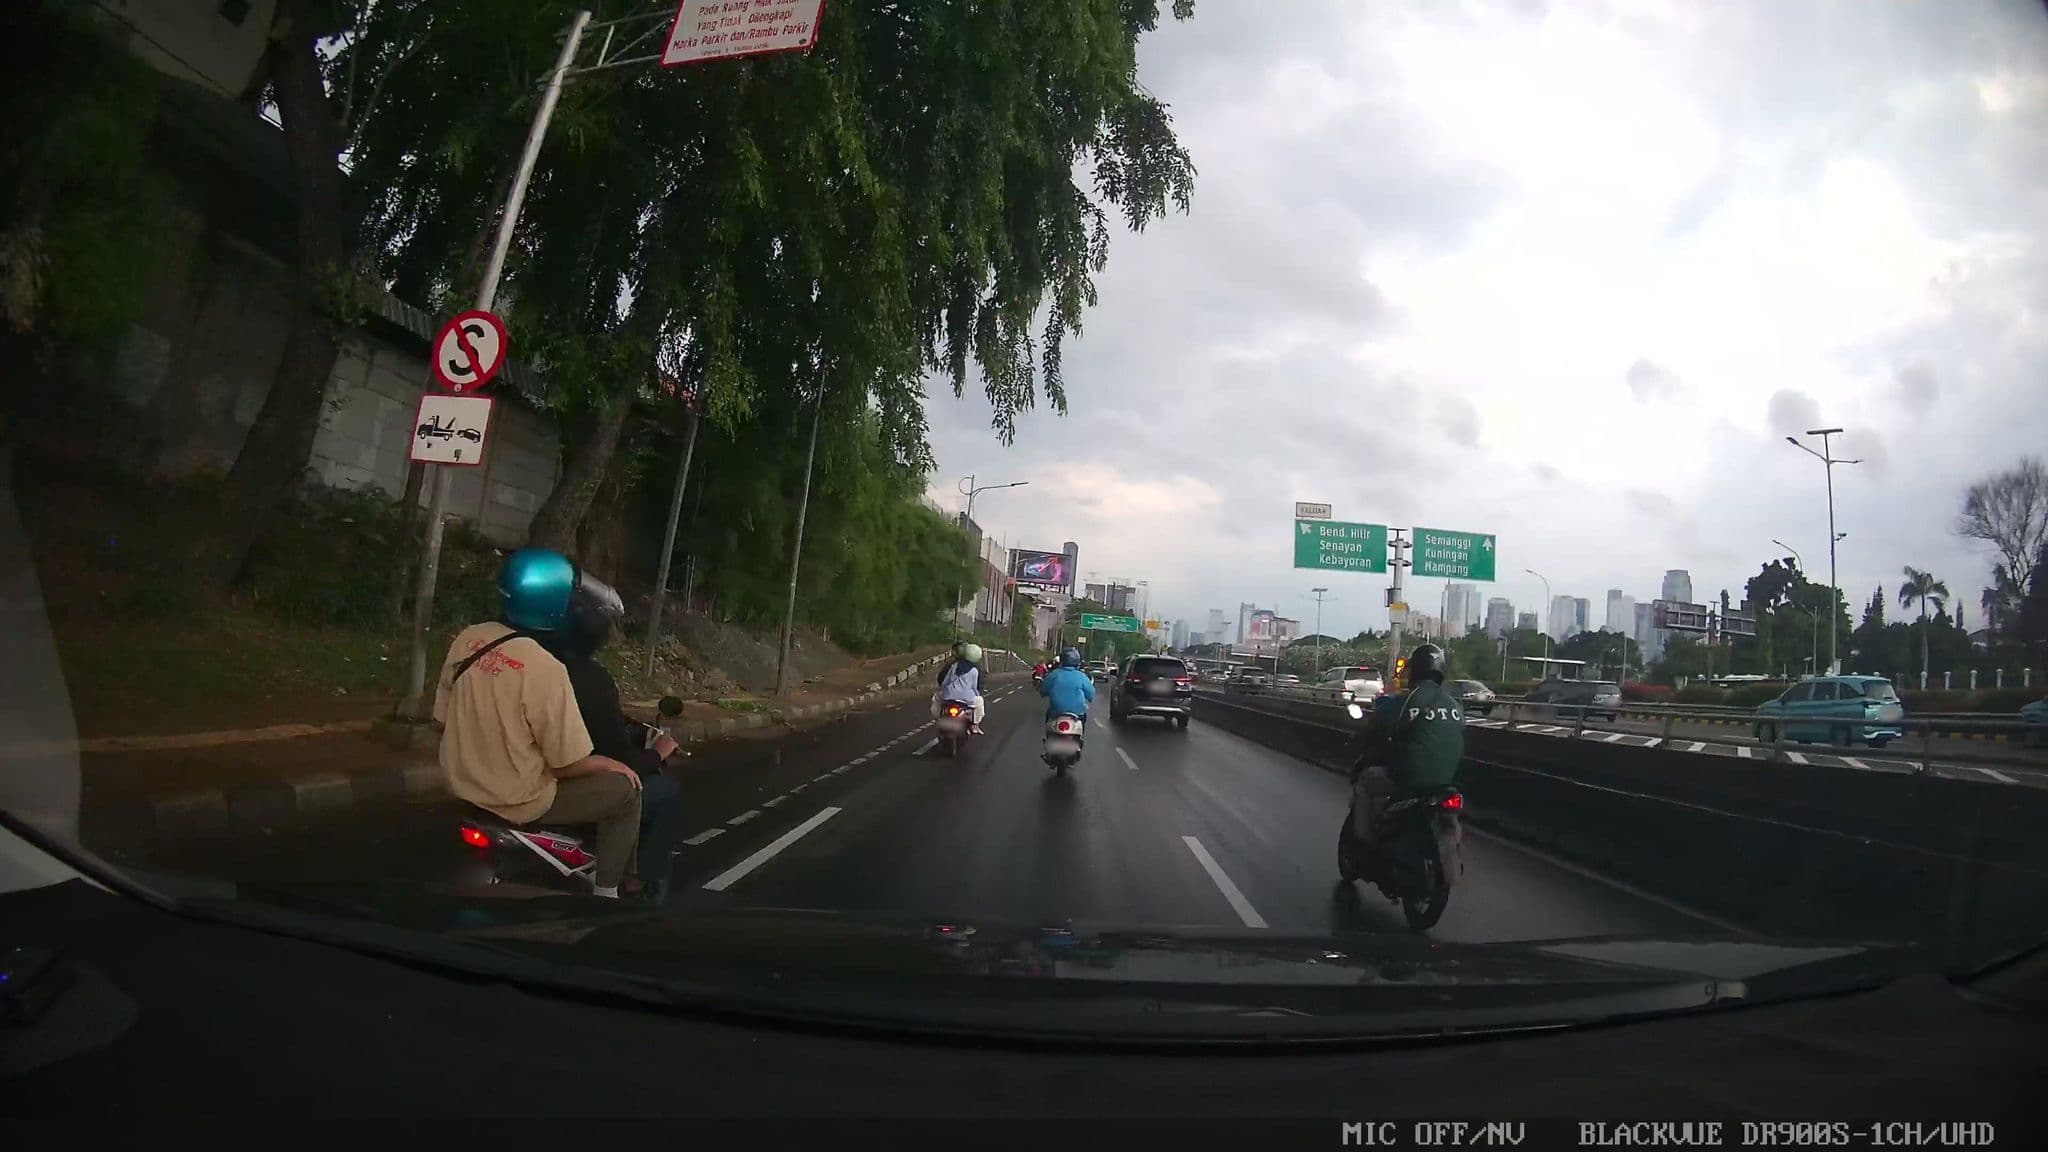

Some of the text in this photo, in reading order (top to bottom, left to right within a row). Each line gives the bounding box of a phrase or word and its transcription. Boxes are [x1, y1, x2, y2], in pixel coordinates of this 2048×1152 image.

[697, 20, 717, 31] Yang
[673, 38, 697, 50] Marka
[701, 32, 727, 45] Parkir
[783, 21, 808, 35] Parkir
[1351, 528, 1370, 539] Hilir
[1319, 540, 1362, 553] Senayan
[1425, 534, 1471, 549] Semanggi
[1319, 553, 1372, 568] Kebayoran
[1425, 548, 1468, 562] Kuningan
[1424, 561, 1469, 577] Mampang
